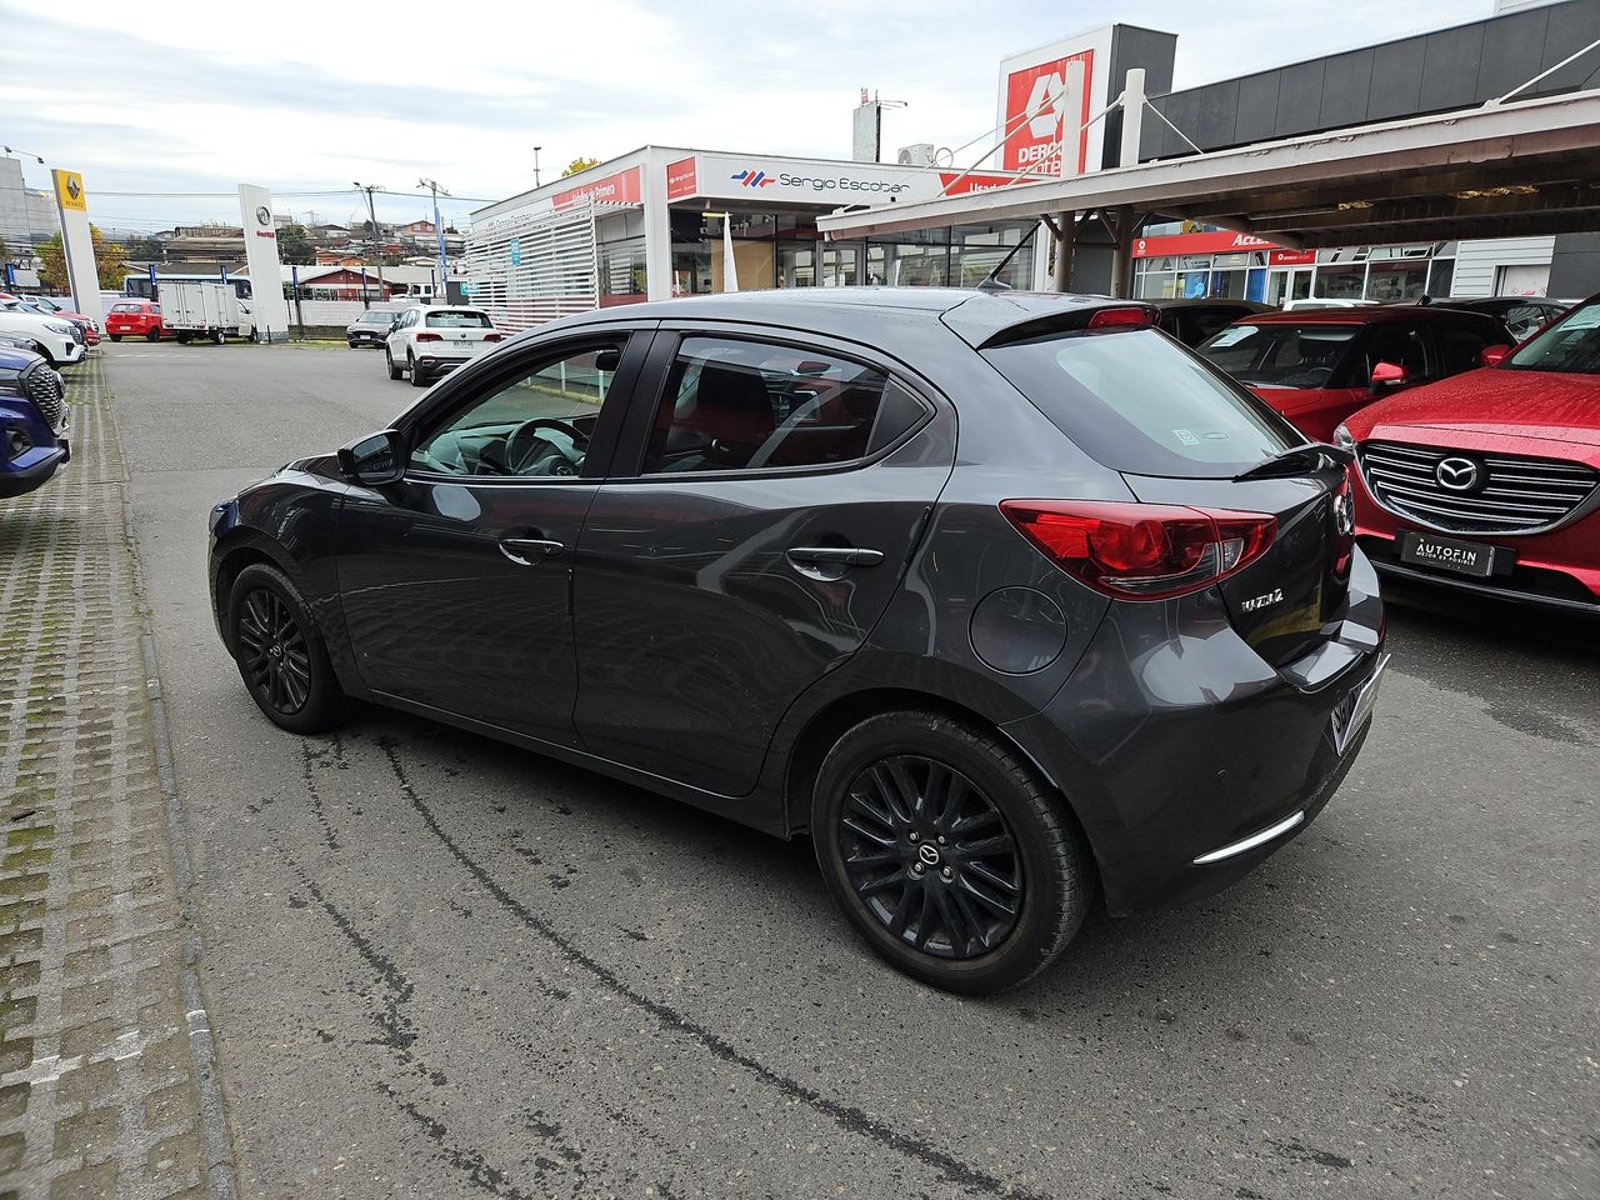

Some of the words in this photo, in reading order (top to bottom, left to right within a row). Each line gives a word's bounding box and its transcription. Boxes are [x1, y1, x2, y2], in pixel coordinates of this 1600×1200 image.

[779, 173, 836, 191] Sergio
[839, 177, 911, 194] Escobar
[1416, 543, 1477, 562] AUTOFIN
